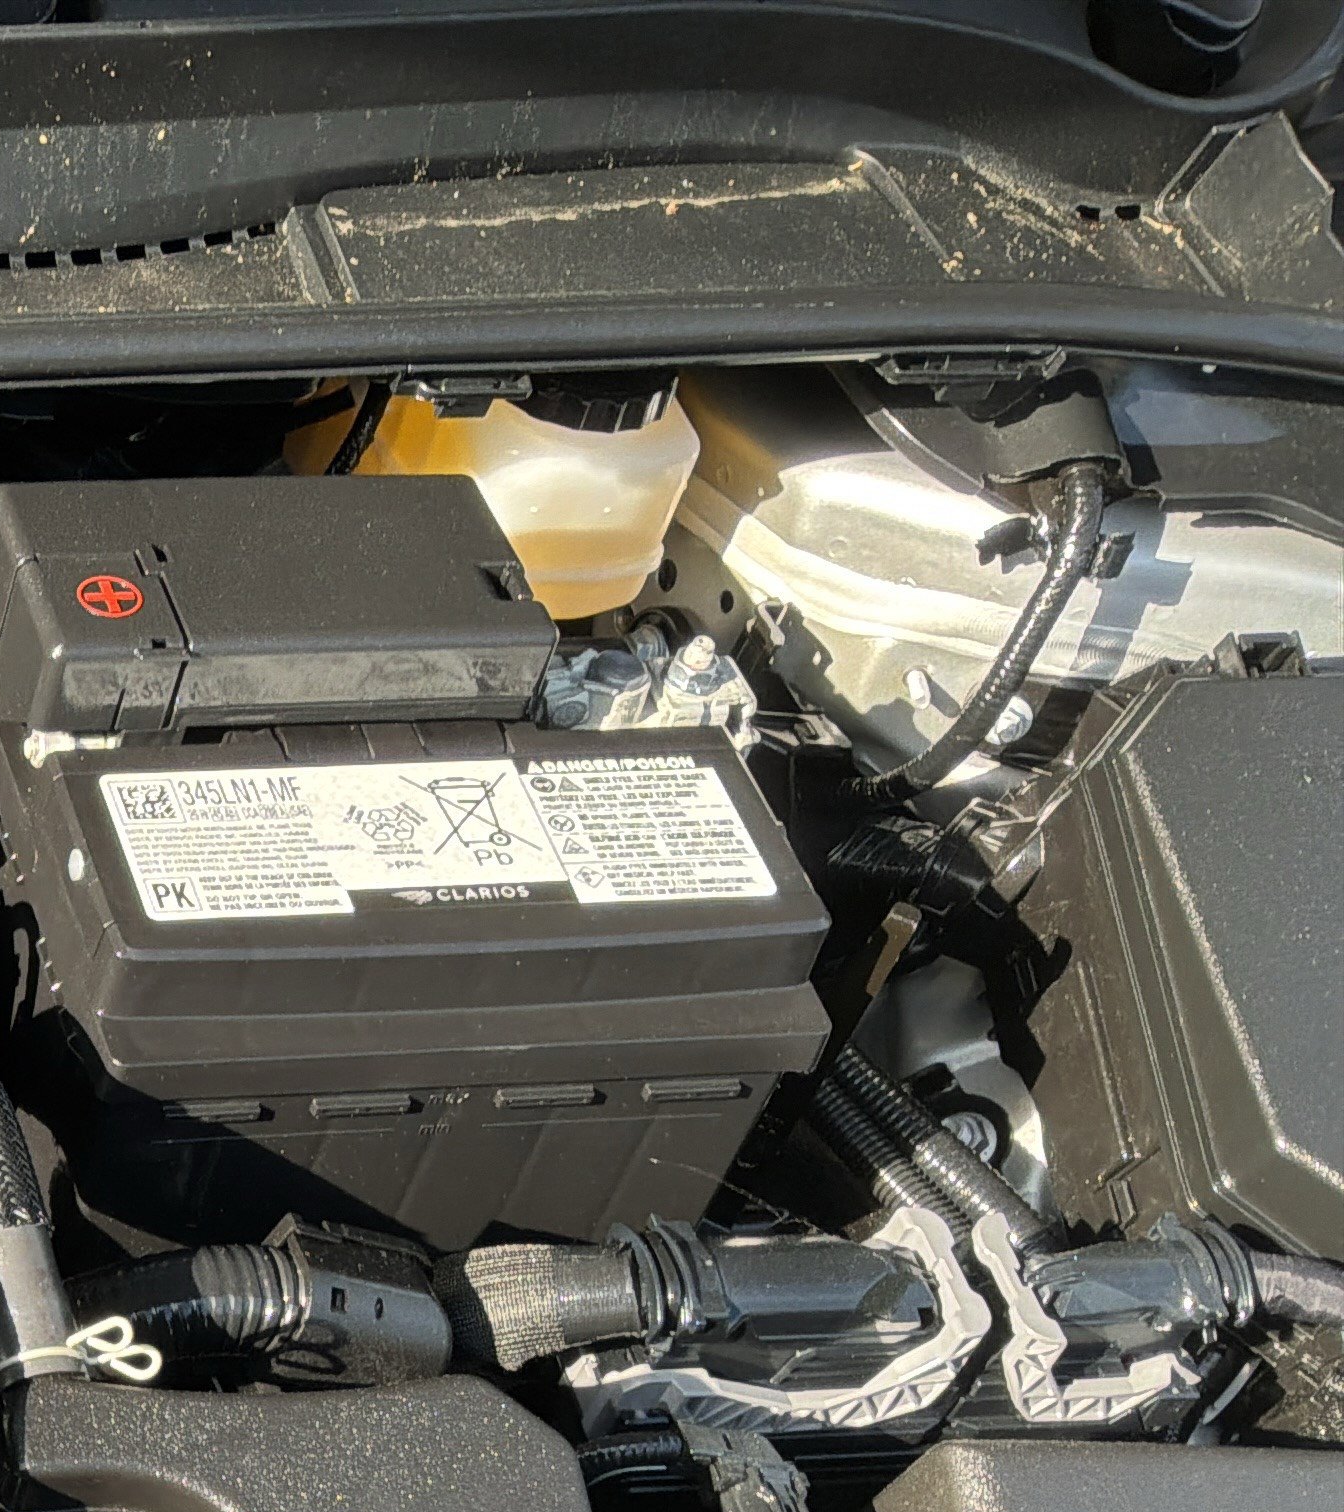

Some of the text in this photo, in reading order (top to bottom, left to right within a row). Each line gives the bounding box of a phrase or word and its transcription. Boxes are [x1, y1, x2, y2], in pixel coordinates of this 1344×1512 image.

[541, 756, 696, 773] DANGER/POISON
[178, 776, 301, 805] 345LN1-MF
[473, 848, 514, 866] Pb
[151, 882, 196, 909] PK
[436, 885, 530, 902] CLARIOS
